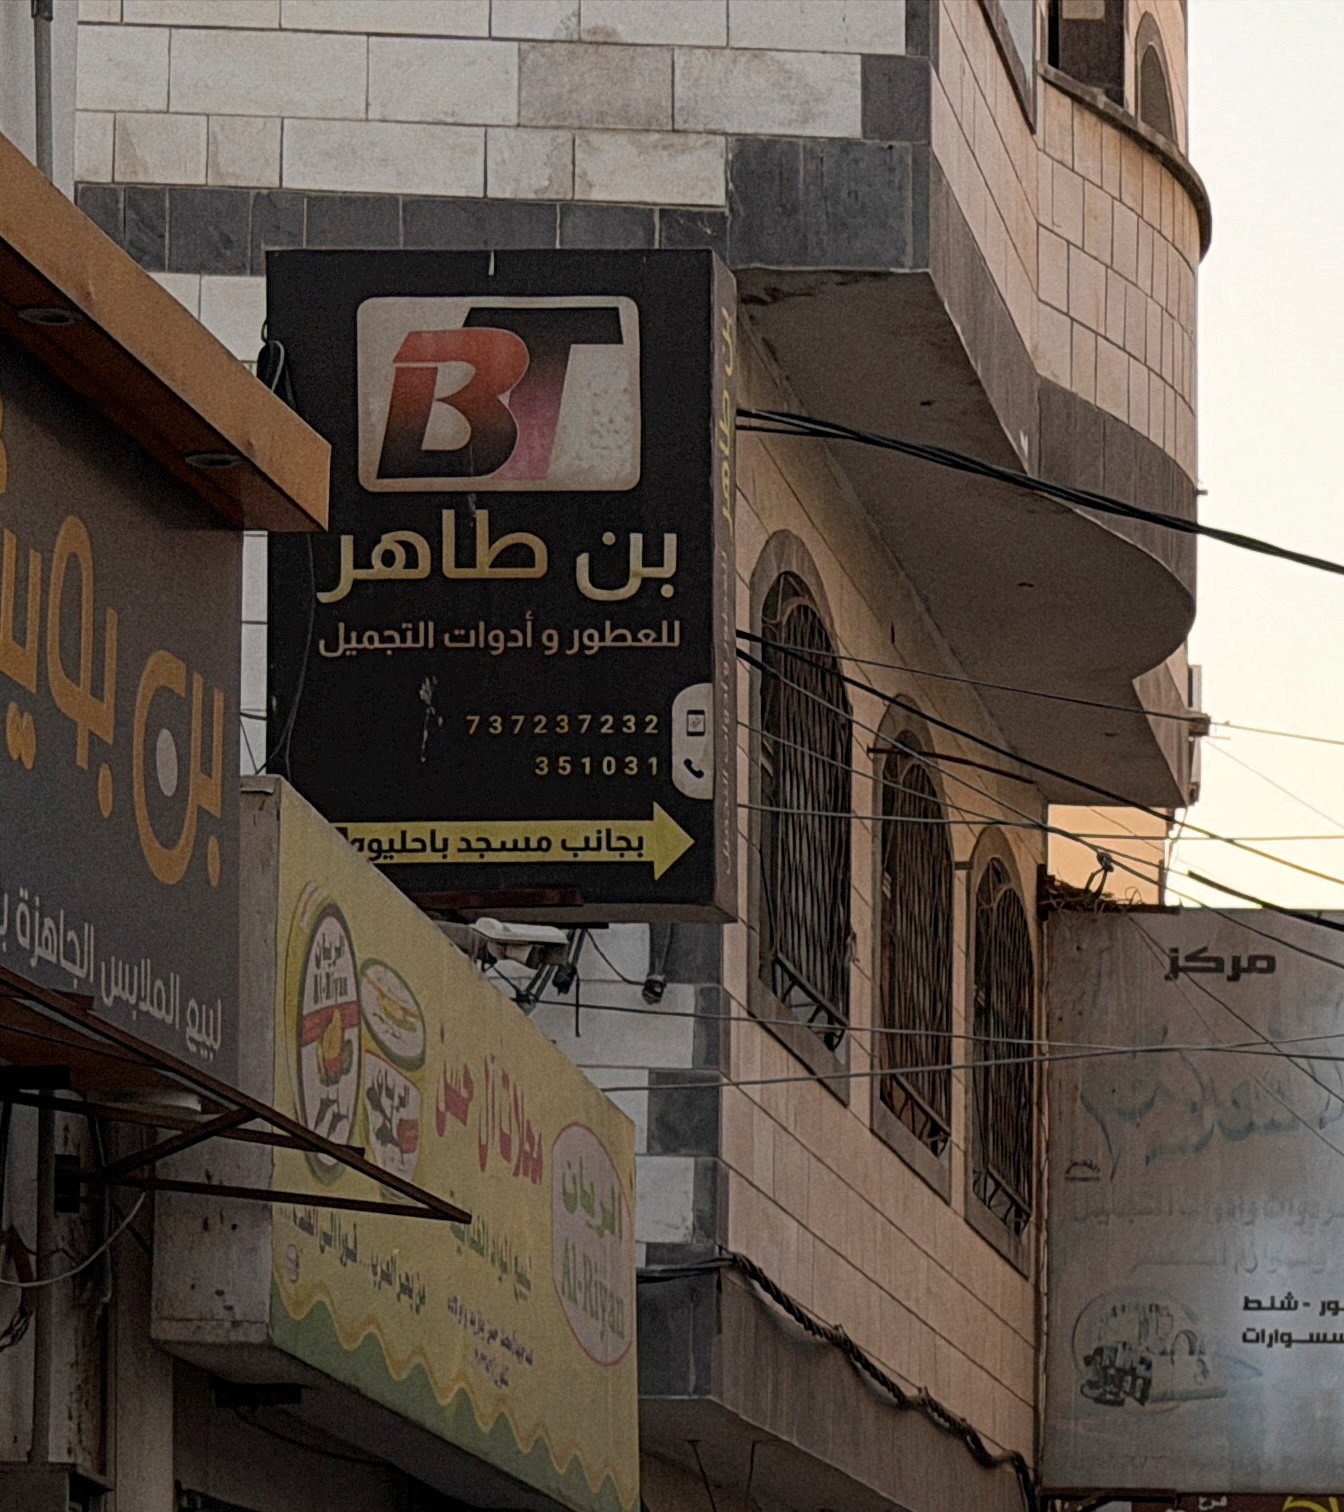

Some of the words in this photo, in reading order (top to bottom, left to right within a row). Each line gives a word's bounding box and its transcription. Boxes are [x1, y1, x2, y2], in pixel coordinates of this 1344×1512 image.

[376, 306, 625, 480] BT
[316, 508, 548, 604] طاهر
[575, 530, 679, 602] بن
[318, 620, 436, 657] التجميل
[443, 610, 535, 654] أدوات
[541, 629, 558, 657] و
[566, 620, 681, 656] للعطور
[465, 713, 660, 736] 737237232
[134, 650, 224, 888] بن
[534, 754, 660, 778] 351031
[456, 833, 553, 860] مسجد
[561, 827, 646, 858] بجانب
[16, 887, 96, 985] الجاهزة
[1164, 946, 1276, 982] مركز
[100, 955, 181, 1031] الملابس
[185, 999, 223, 1061] لبيع
[1243, 1291, 1299, 1312] شنط
